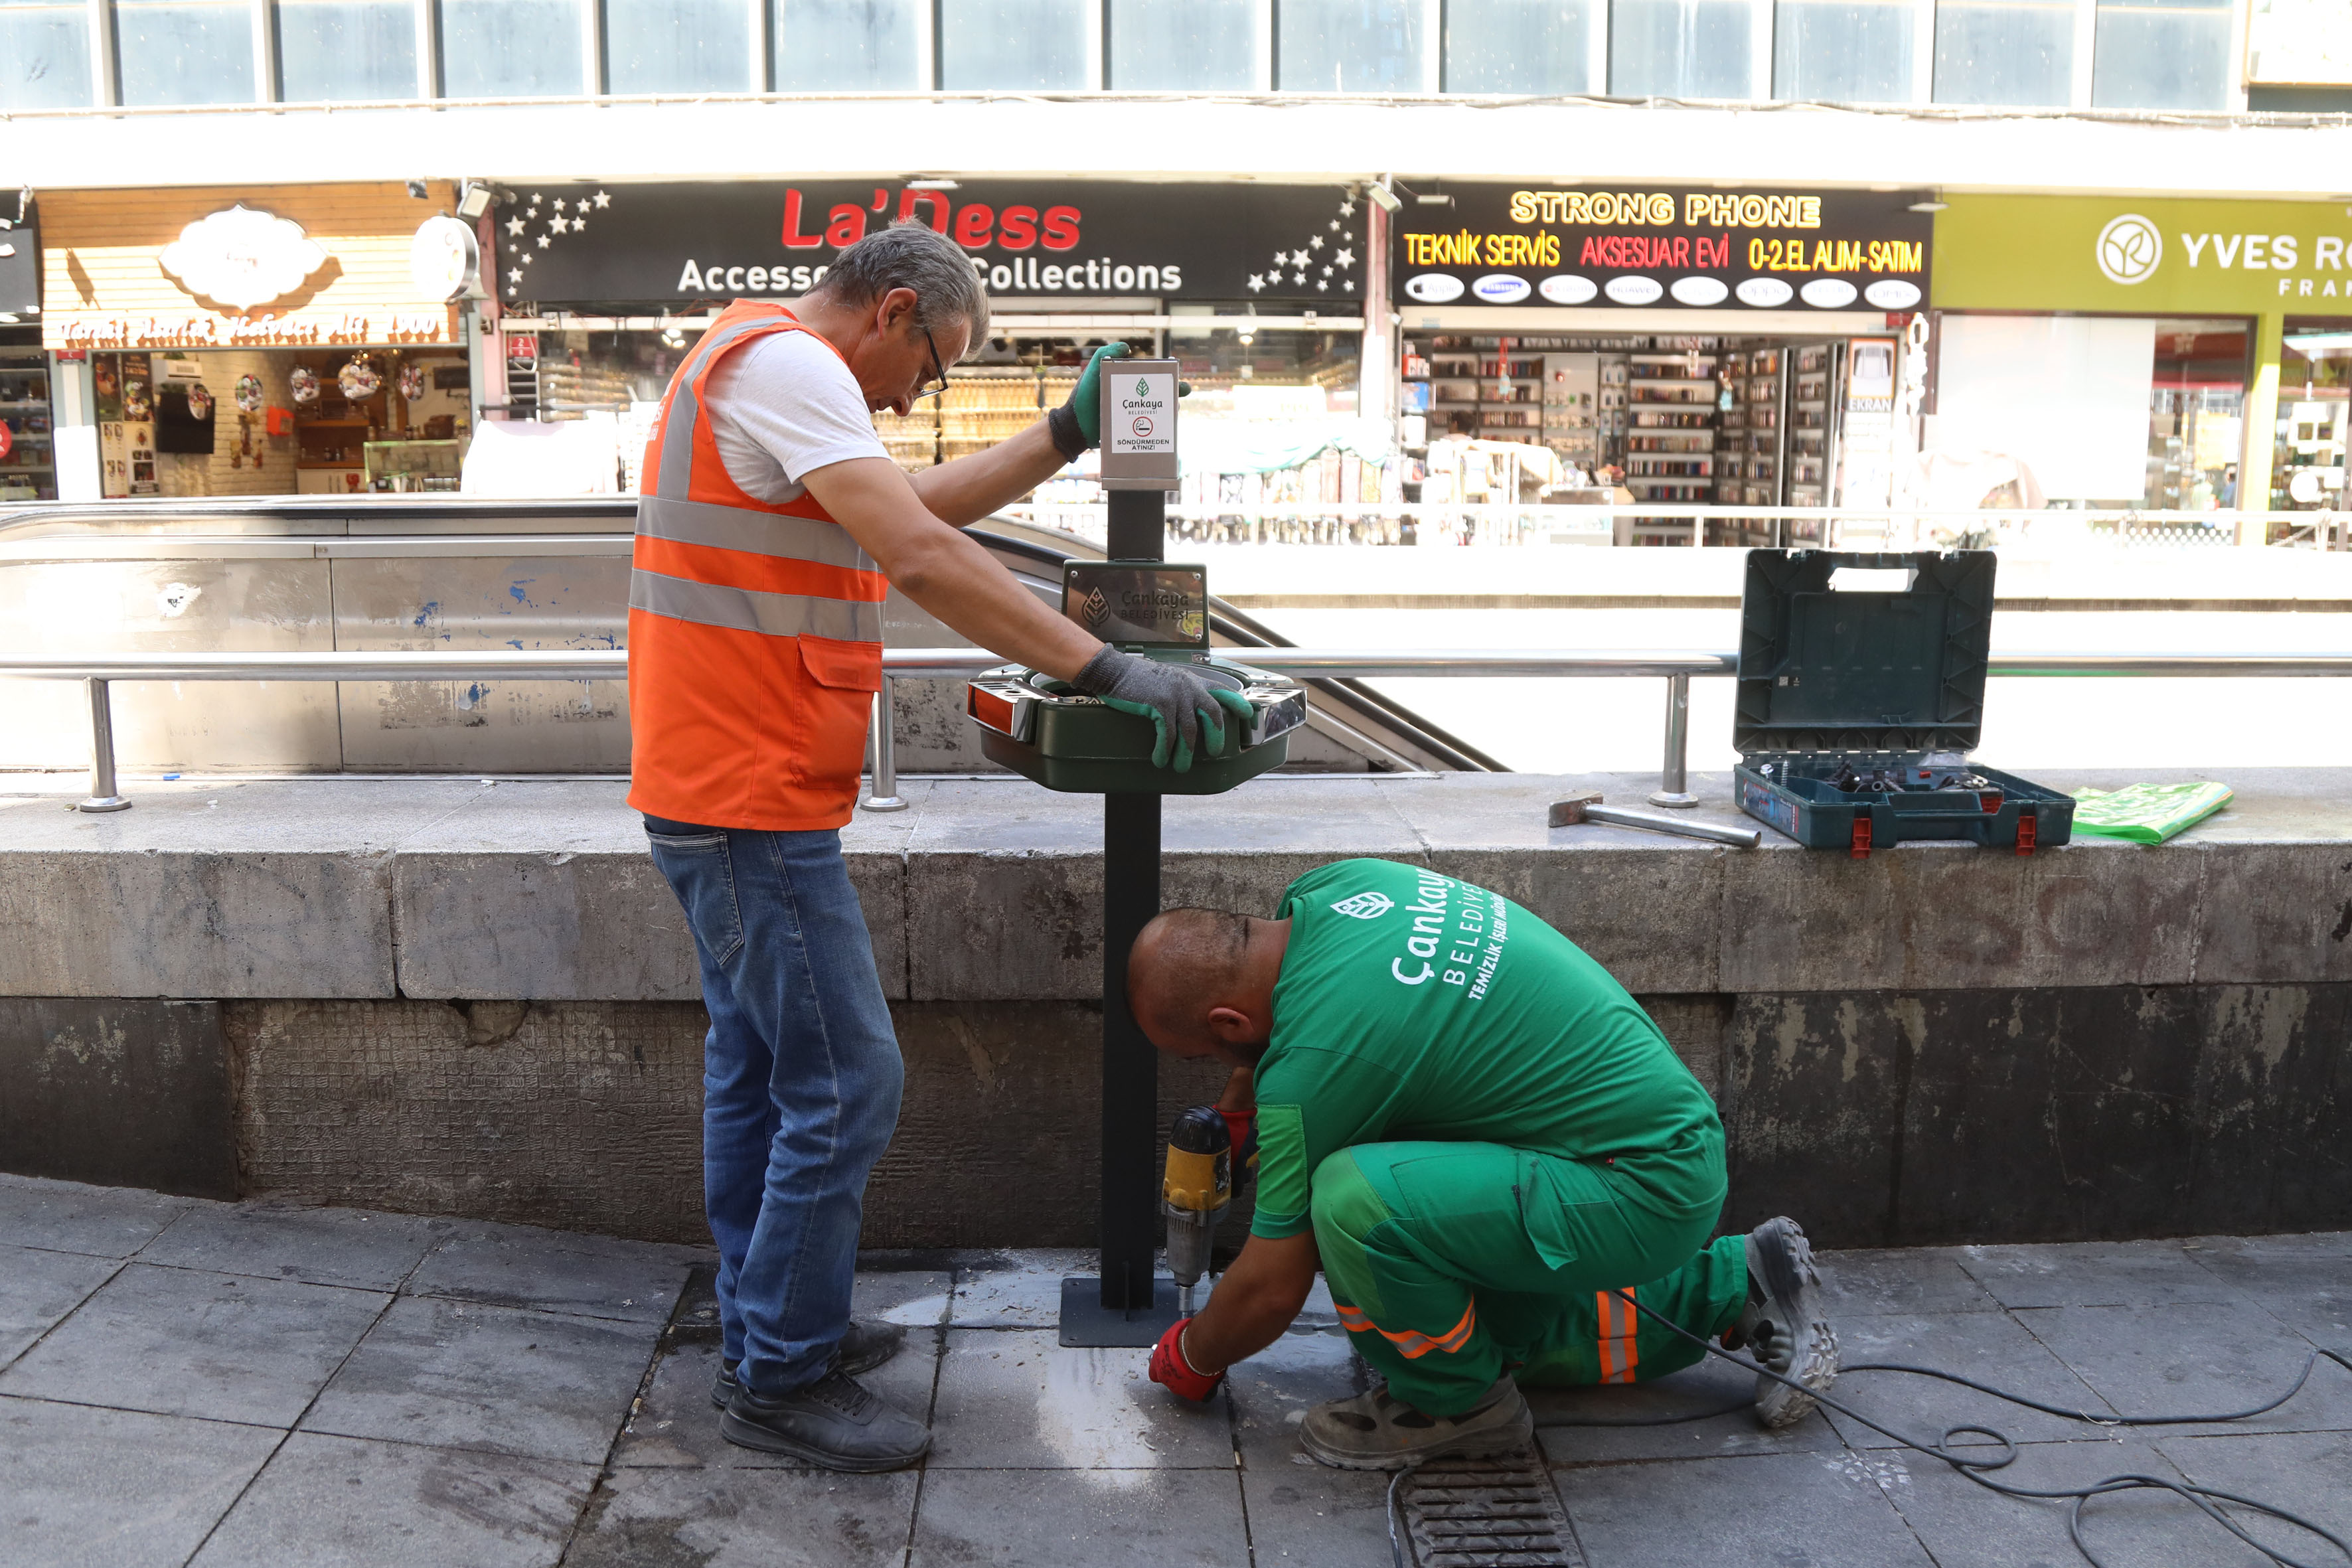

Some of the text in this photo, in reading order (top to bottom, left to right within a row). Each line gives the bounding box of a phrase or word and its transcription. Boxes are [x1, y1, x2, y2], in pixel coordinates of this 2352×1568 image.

[1510, 191, 1822, 228] STRONG PHONE
[1403, 228, 1561, 266] TEKNİK SERVİS
[1580, 233, 1729, 269] AKSESUAR EVİ
[2181, 233, 2352, 271] YVES R
[677, 259, 830, 292] Access
[1123, 399, 1163, 410] Çankaya
[1849, 398, 1891, 412] EKRAN
[1121, 591, 1189, 609] Çankaya
[1121, 609, 1188, 620] BELEDİYESİ
